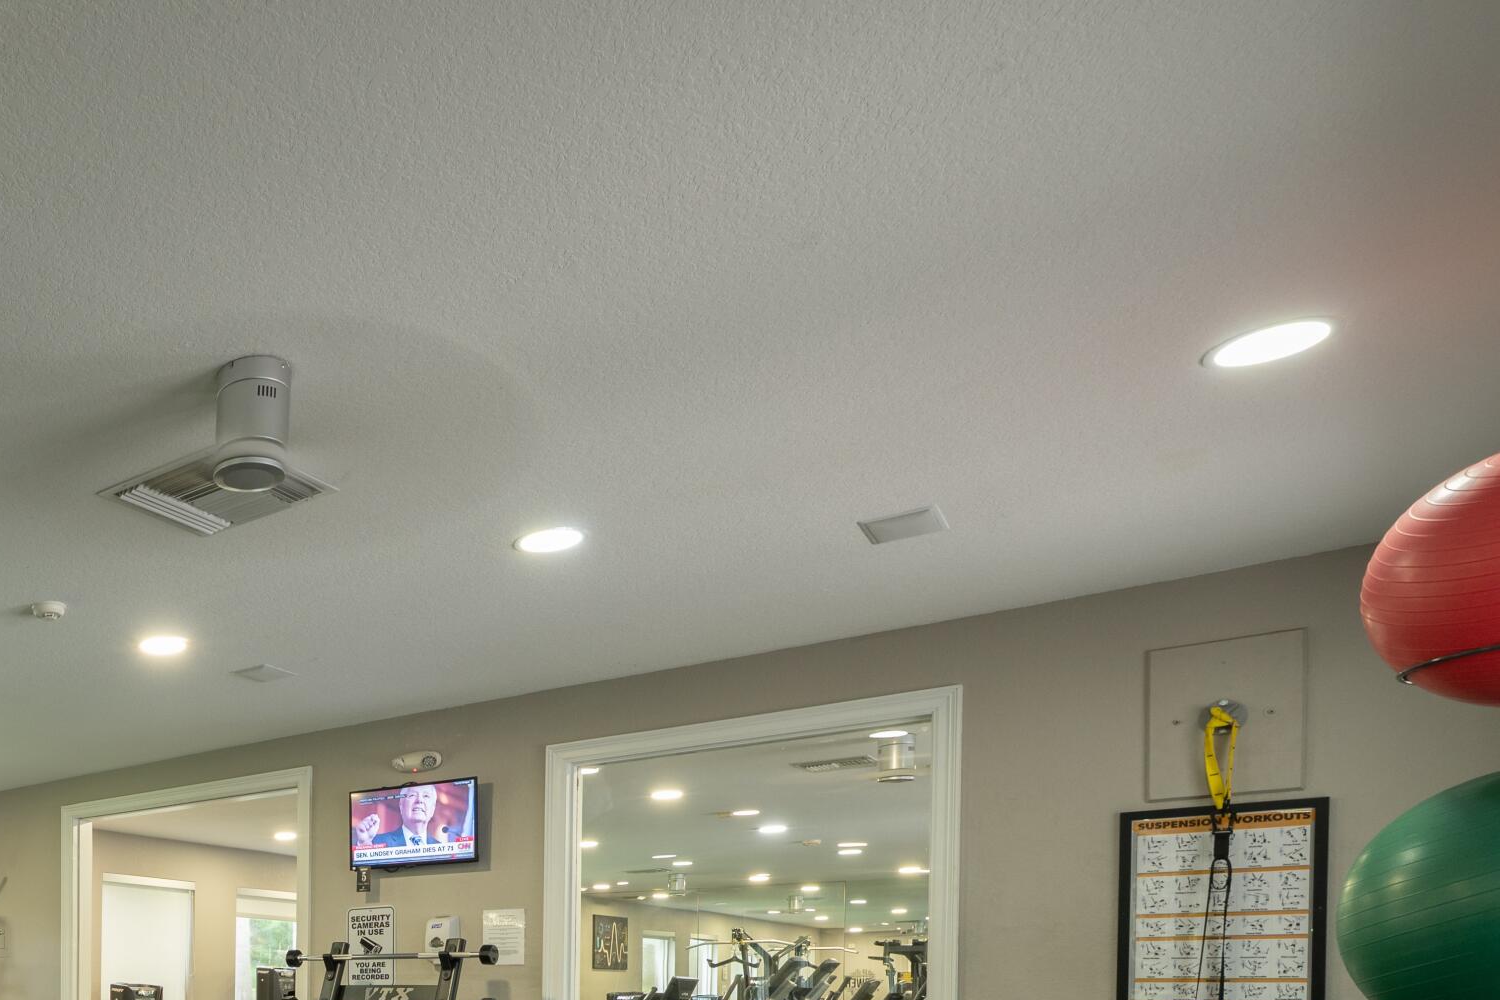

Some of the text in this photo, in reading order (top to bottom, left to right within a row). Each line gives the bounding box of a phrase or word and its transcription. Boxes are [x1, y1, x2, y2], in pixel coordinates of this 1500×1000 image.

[1137, 817, 1223, 831] SUSPENSION
[457, 842, 471, 850] CNN
[356, 851, 369, 859] SEN.
[370, 850, 393, 858] LINDSEY
[395, 848, 421, 856] GRAHAM
[350, 914, 391, 923] SECURITY
[351, 921, 390, 929] CAMERAS
[368, 928, 384, 936] USE
[364, 987, 414, 1000] VTX
